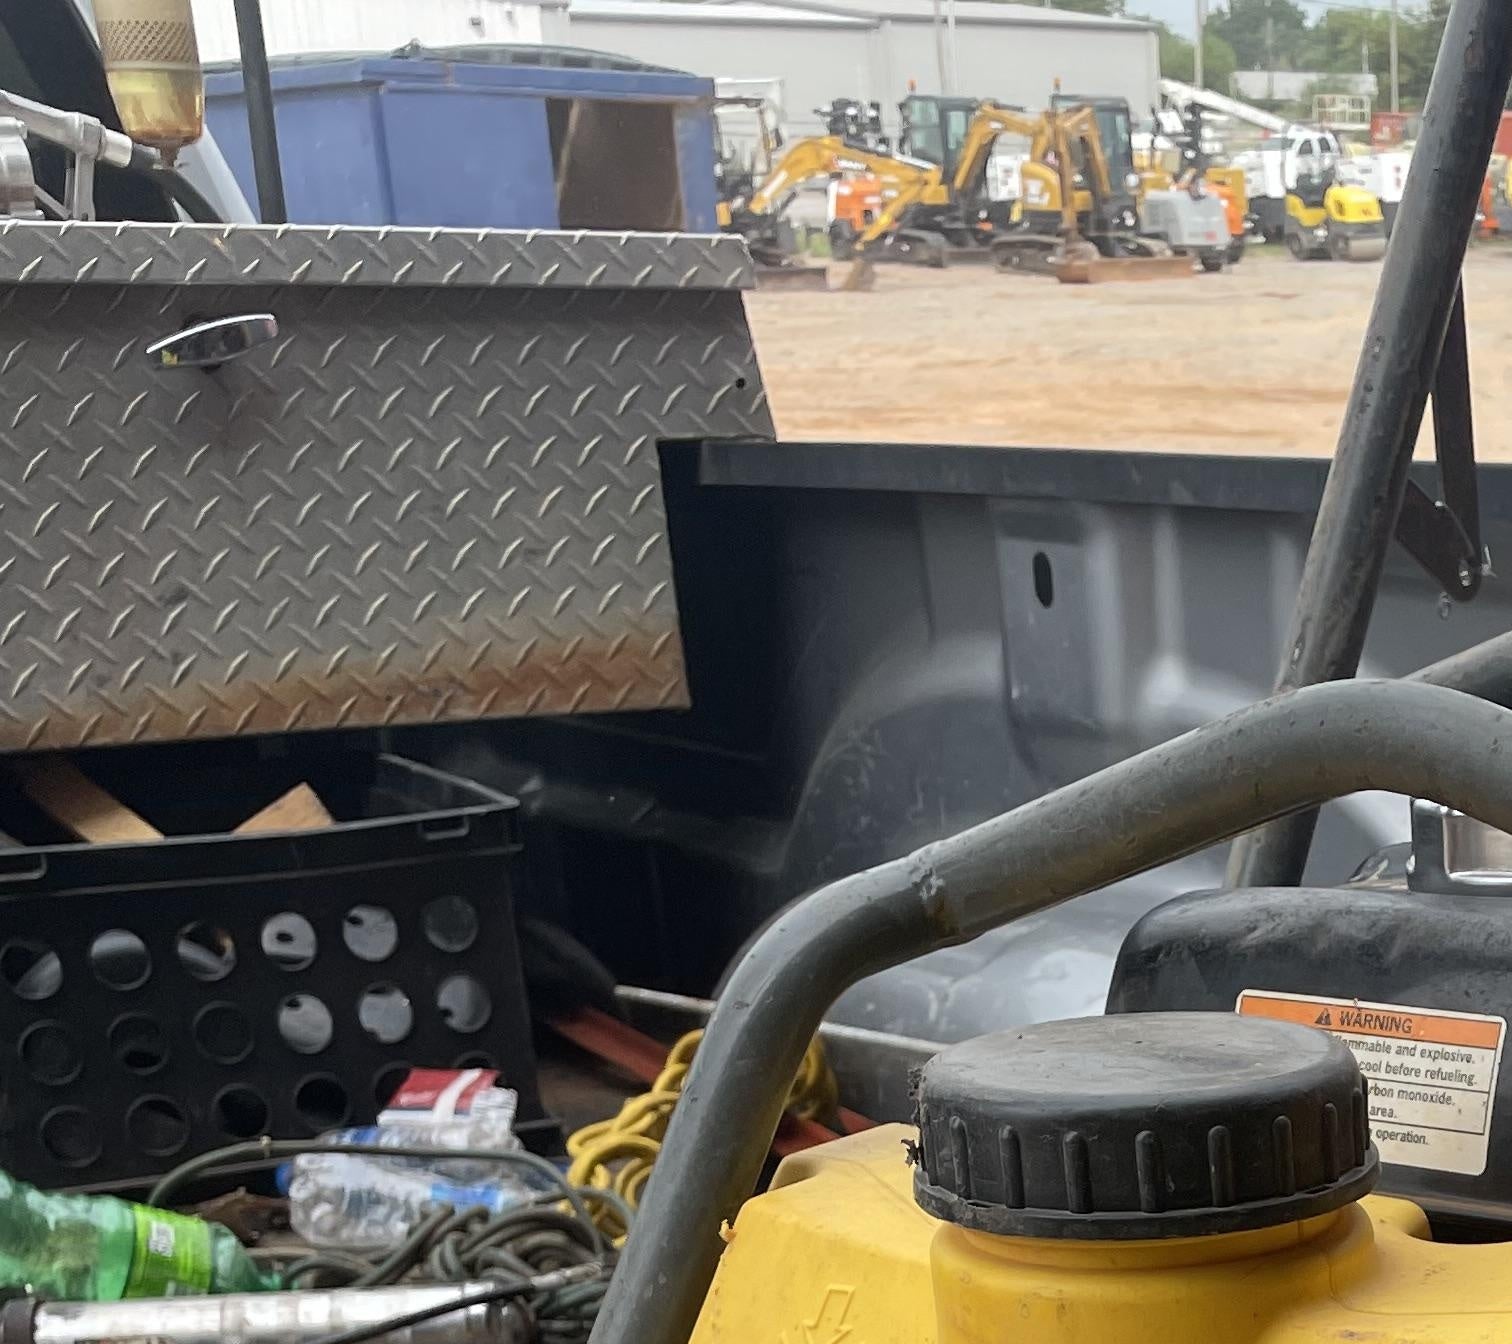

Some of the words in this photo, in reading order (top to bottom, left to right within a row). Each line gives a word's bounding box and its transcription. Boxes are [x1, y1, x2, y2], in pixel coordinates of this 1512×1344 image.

[1340, 1011, 1413, 1034] WARNING
[1335, 1034, 1392, 1054] ammable
[1395, 1044, 1417, 1057] and
[1420, 1048, 1476, 1064] explosive.
[1359, 1060, 1383, 1073] cool
[1385, 1060, 1421, 1077] before
[1425, 1067, 1478, 1087] refueling.
[1397, 1089, 1456, 1106] monoxide.
[1369, 1105, 1398, 1118] area.
[1375, 1129, 1430, 1145] operation.
